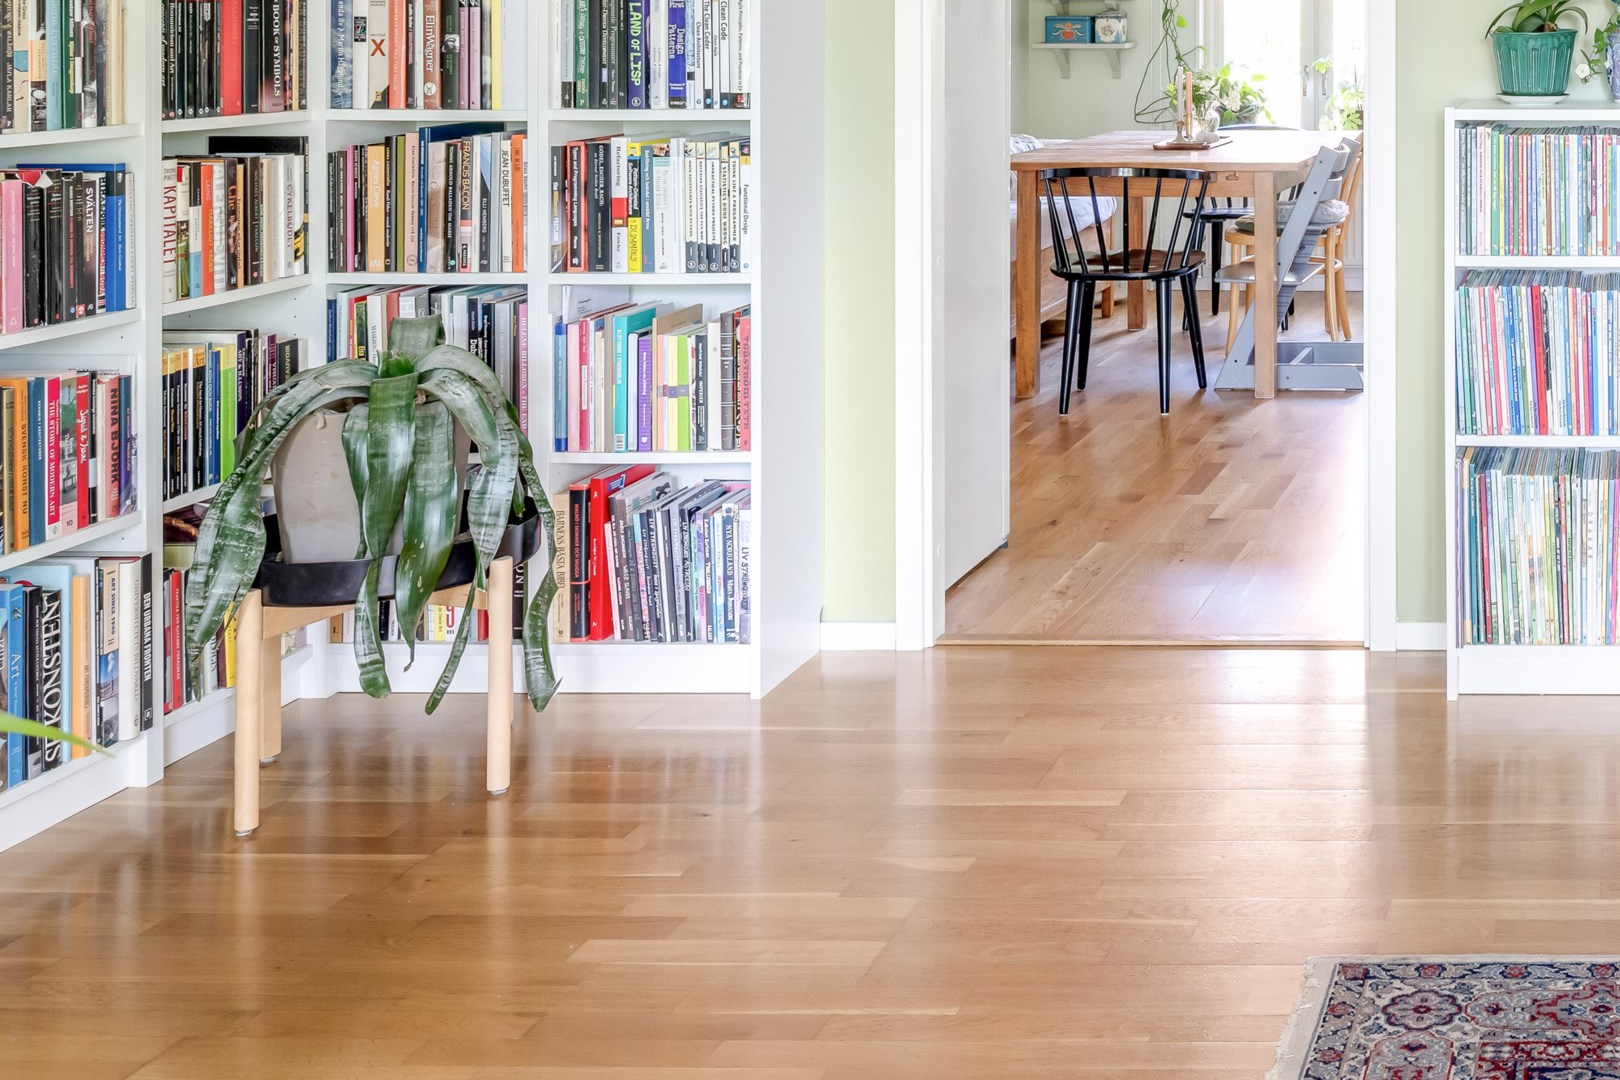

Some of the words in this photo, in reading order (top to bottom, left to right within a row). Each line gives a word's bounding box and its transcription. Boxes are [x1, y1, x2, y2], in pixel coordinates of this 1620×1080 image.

[337, 1, 346, 16] enda
[337, 17, 346, 27] liv
[629, 2, 641, 36] LAND
[338, 34, 346, 56] Martin
[676, 28, 685, 55] Design
[273, 46, 281, 96] SYMBOLS
[629, 52, 641, 86] LISP
[371, 160, 381, 184] Agnes
[462, 141, 470, 176] FRANCIS
[86, 187, 95, 233] SVÄLTEN
[228, 185, 237, 210] Che
[462, 179, 470, 210] BACON
[163, 186, 177, 264] KAPITALET
[111, 388, 119, 427] NINA
[22, 501, 28, 514] NU
[556, 511, 565, 544] BARNENS
[557, 547, 567, 570] BÄSTA
[143, 592, 151, 609] DEN
[143, 610, 151, 644] URBANA
[11, 653, 21, 679] Art
[42, 597, 61, 727] KONSTEN
[143, 645, 151, 681] FRONTEN
